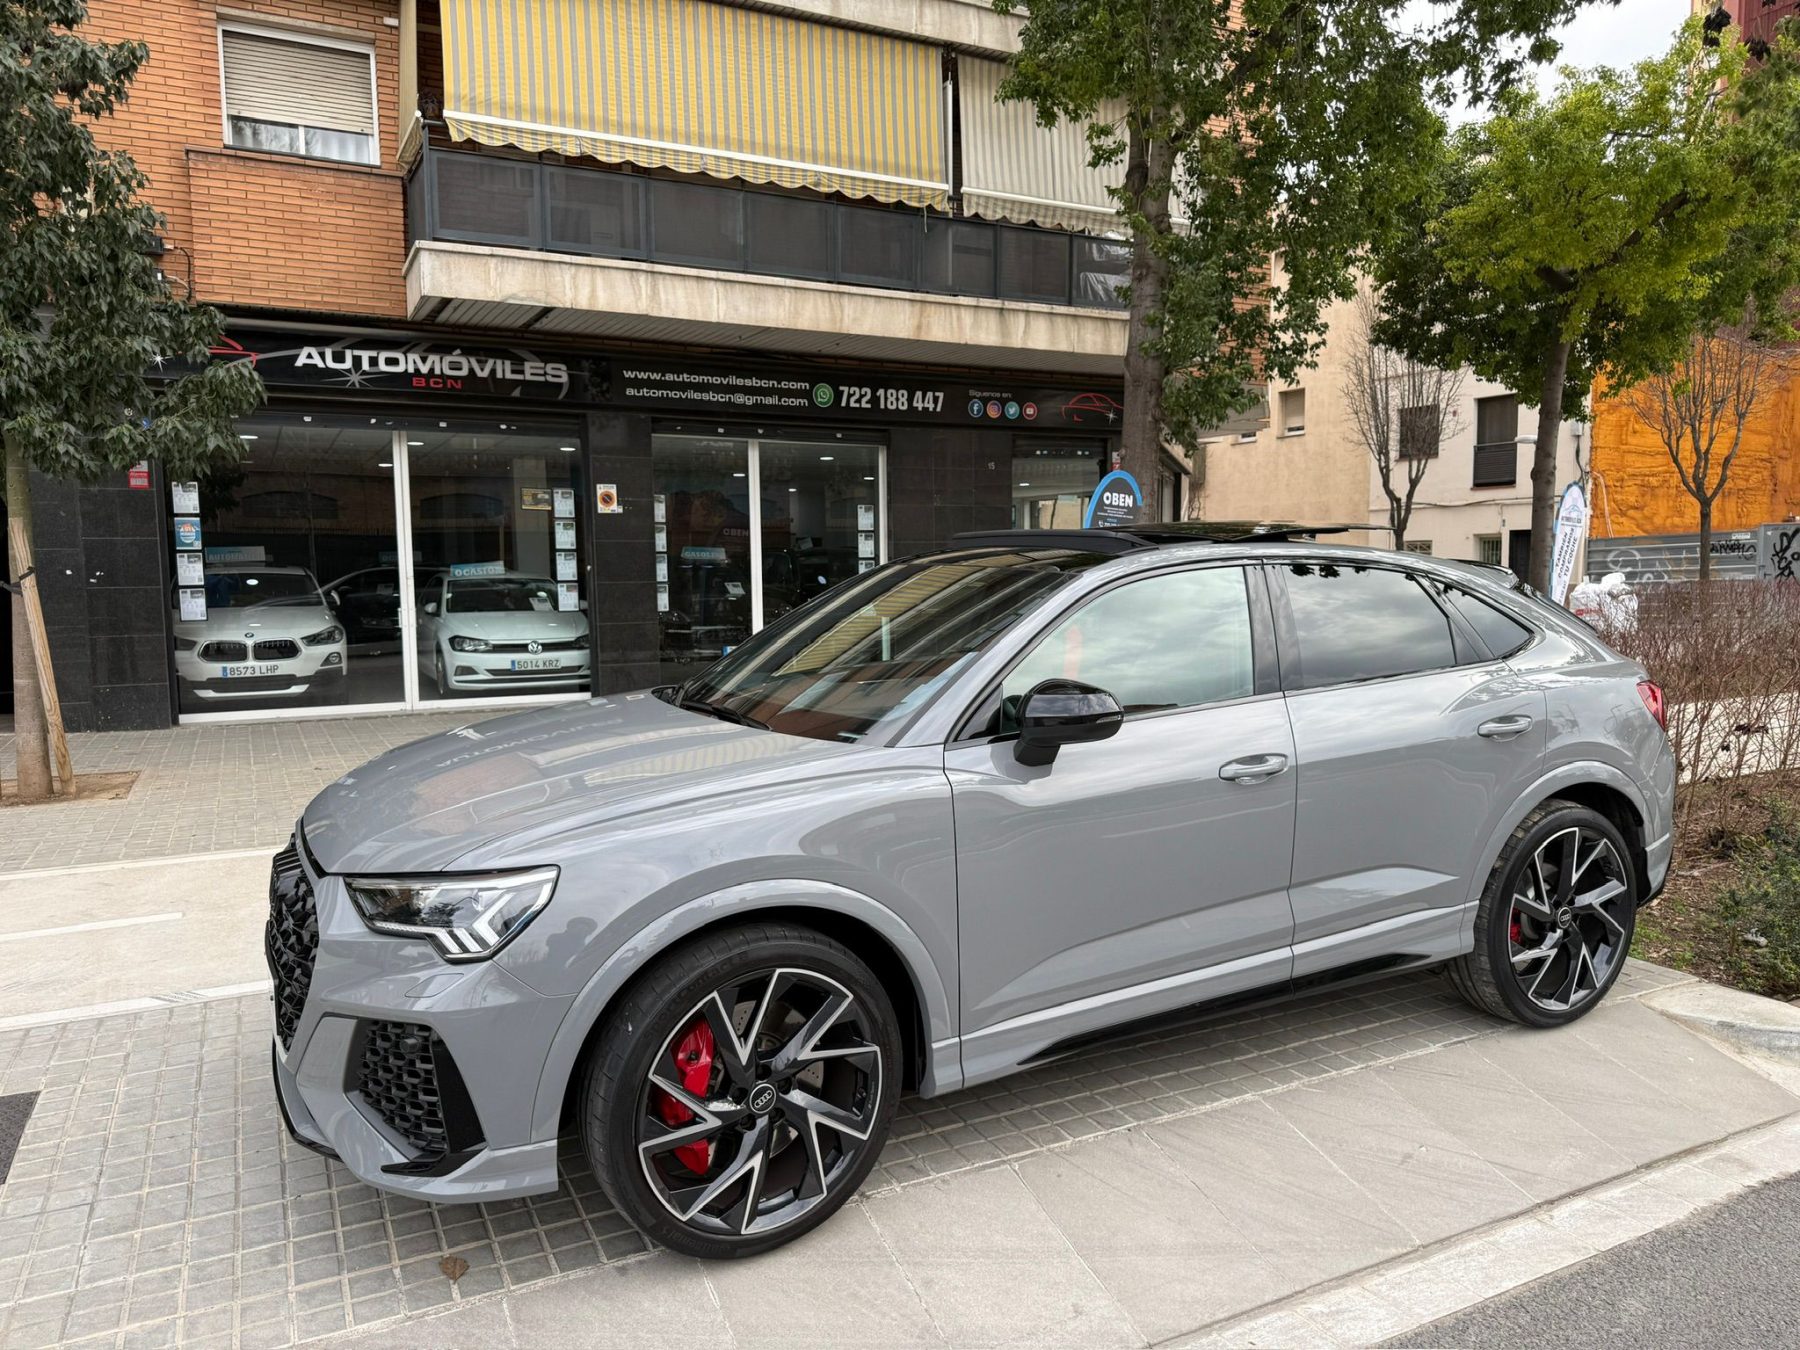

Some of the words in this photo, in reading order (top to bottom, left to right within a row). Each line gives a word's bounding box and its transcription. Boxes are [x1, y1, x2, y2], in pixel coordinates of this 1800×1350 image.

[294, 346, 568, 383] AUTOMÓVILES
[412, 377, 463, 389] BCN
[623, 369, 809, 390] www.automovilesbcn.com
[625, 387, 808, 407] automovilesbcn@gmail.com
[839, 386, 871, 408] 722
[876, 388, 908, 411] 188
[913, 391, 944, 412] 447
[988, 462, 995, 470] 15
[1103, 491, 1133, 507] OBEN
[229, 666, 256, 676] 8573
[259, 664, 279, 675] LHP
[517, 660, 540, 669] 5014
[543, 659, 560, 668] KRZ
